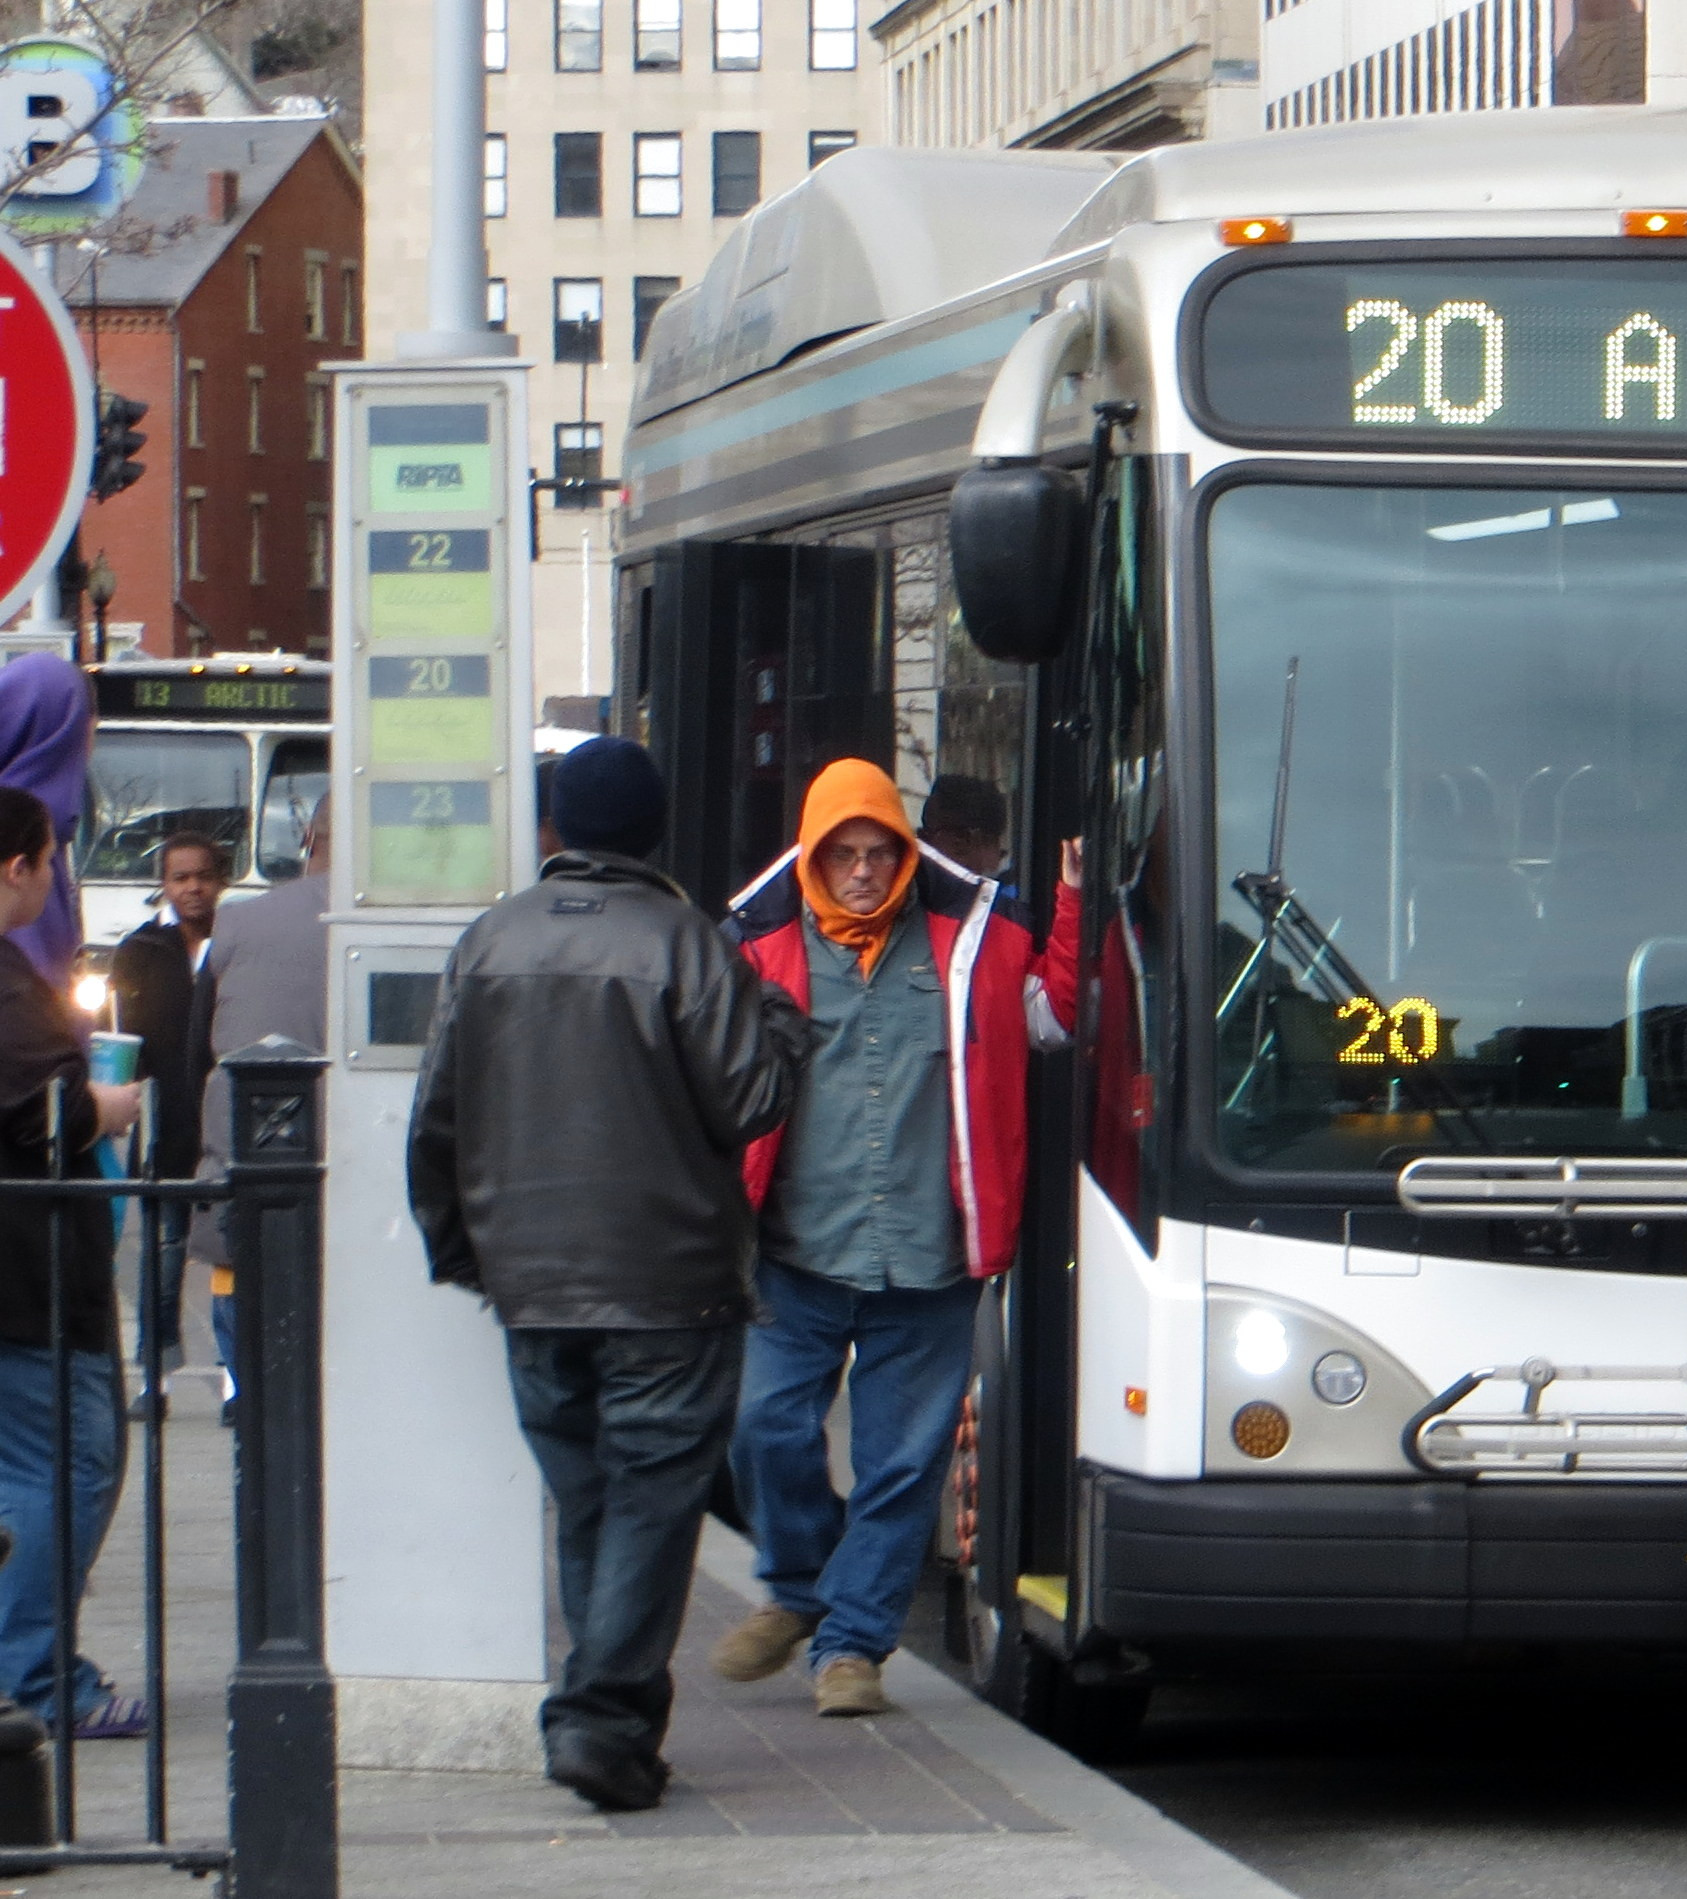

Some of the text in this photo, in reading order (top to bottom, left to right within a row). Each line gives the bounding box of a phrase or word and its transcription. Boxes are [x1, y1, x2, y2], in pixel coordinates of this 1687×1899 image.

[1345, 299, 1505, 426] 20
[397, 463, 463, 488] RIPTA
[408, 532, 451, 568] 22
[408, 657, 451, 692] 20
[411, 785, 455, 819] 23
[1336, 997, 1438, 1064] 20
